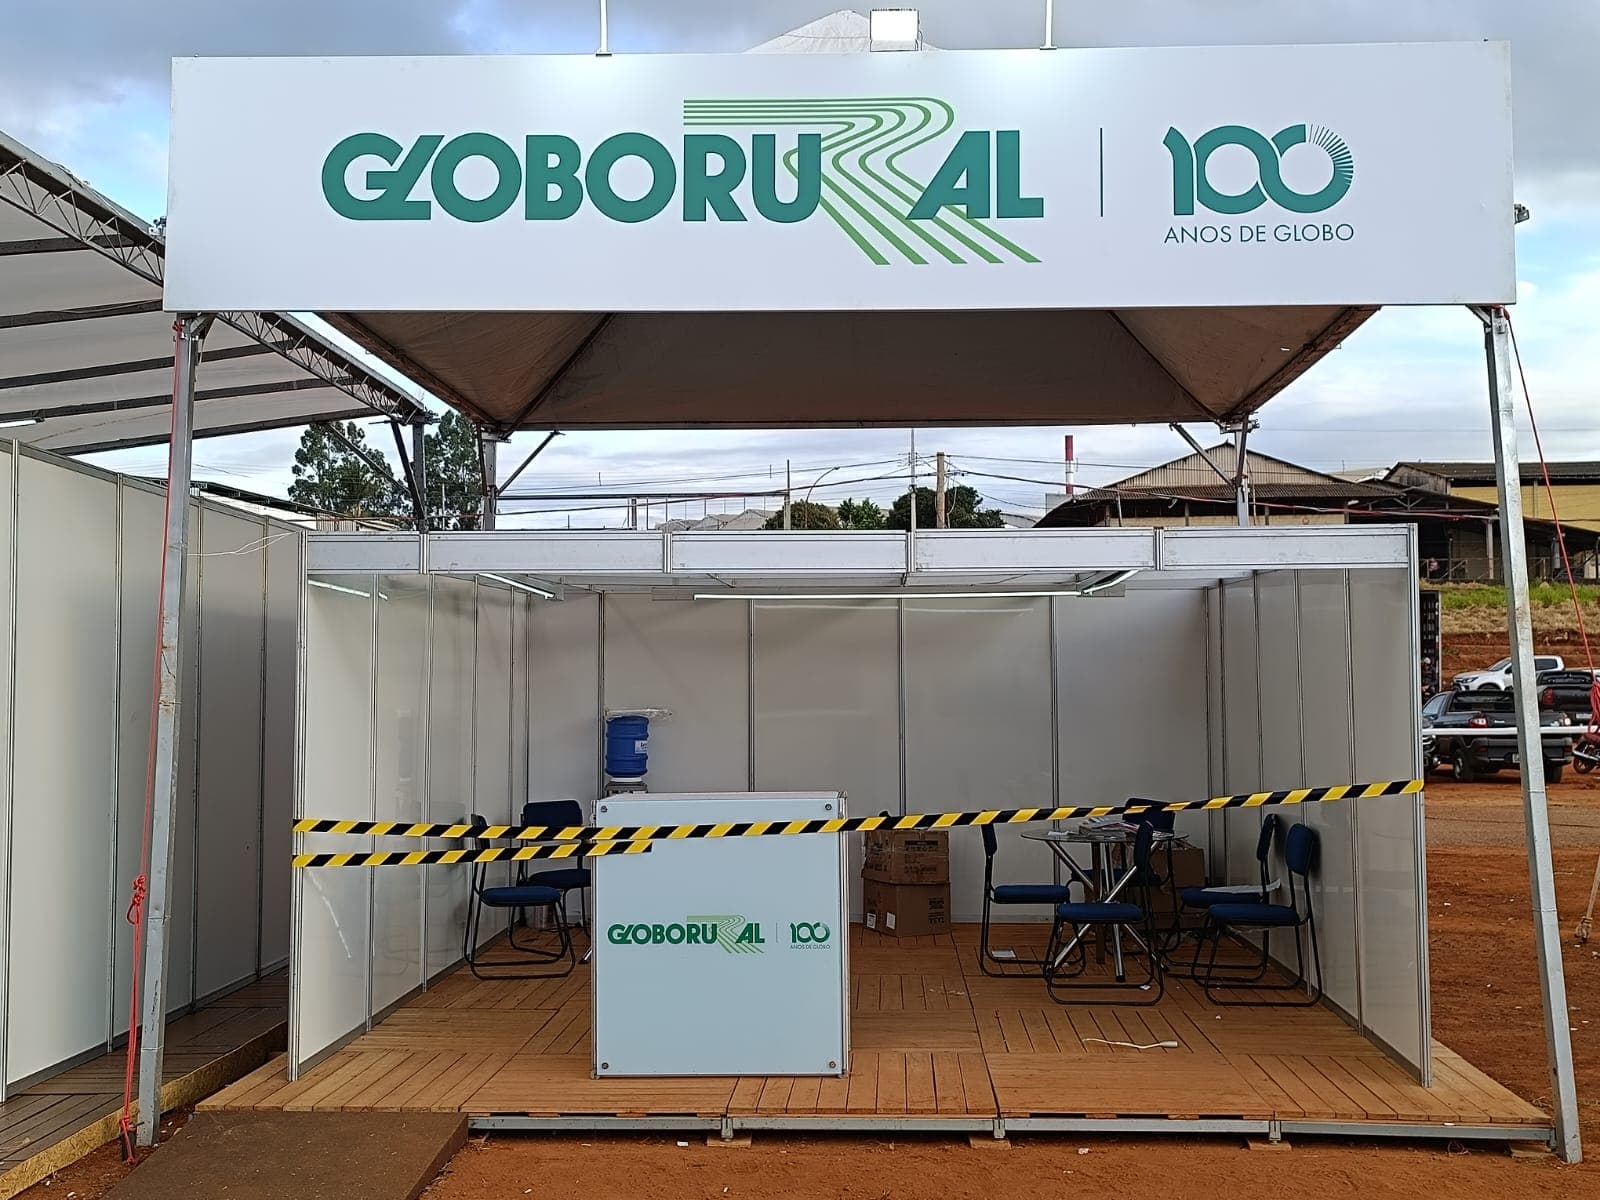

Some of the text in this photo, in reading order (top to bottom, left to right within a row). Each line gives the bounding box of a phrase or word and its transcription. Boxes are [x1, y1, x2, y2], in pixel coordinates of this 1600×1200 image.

[1163, 124, 1353, 215] 100
[1164, 223, 1354, 243] ANOS DE GLOBO
[790, 922, 830, 943] 100
